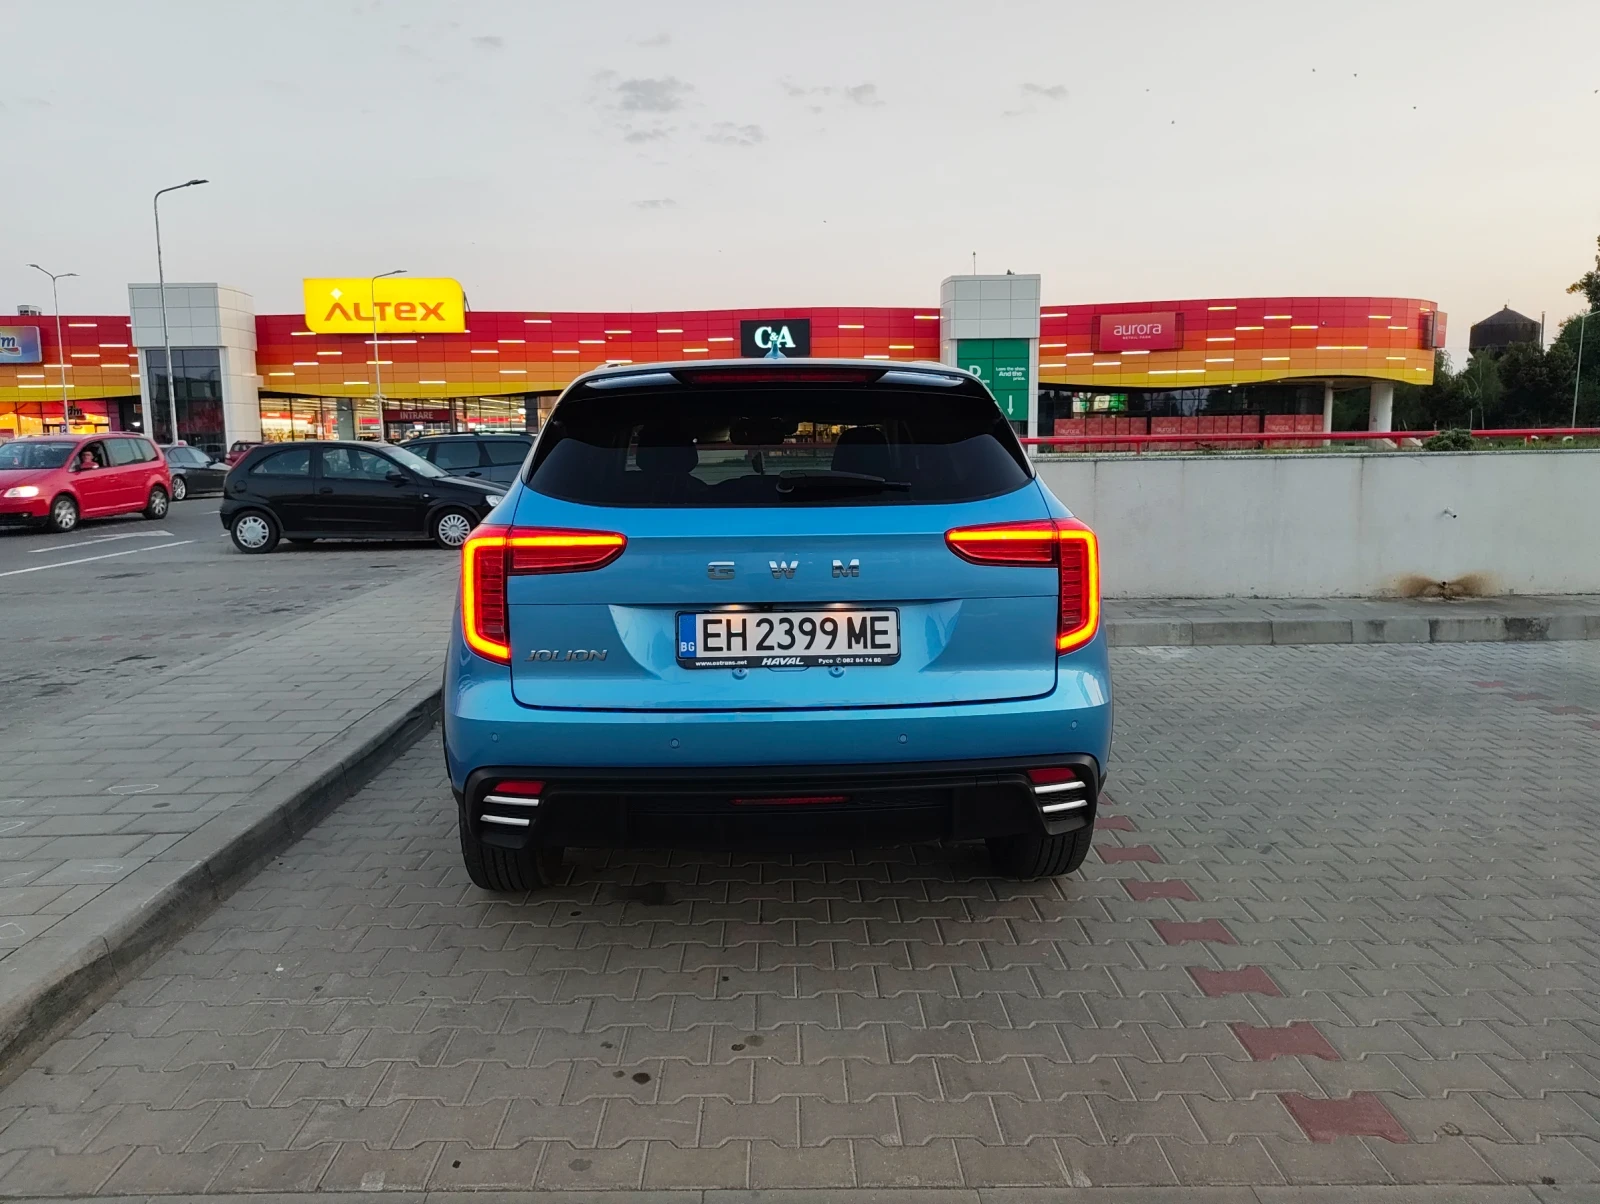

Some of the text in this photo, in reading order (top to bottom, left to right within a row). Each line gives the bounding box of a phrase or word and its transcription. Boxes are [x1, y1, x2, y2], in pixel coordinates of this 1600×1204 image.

[324, 302, 446, 321] ALTEX
[1113, 323, 1162, 336] aurora
[754, 325, 796, 348] C&A
[68, 405, 82, 416] dm
[400, 411, 434, 420] INTRARE
[680, 641, 695, 652] BG
[524, 649, 608, 662] JOLION
[761, 657, 805, 666] HAVAL
